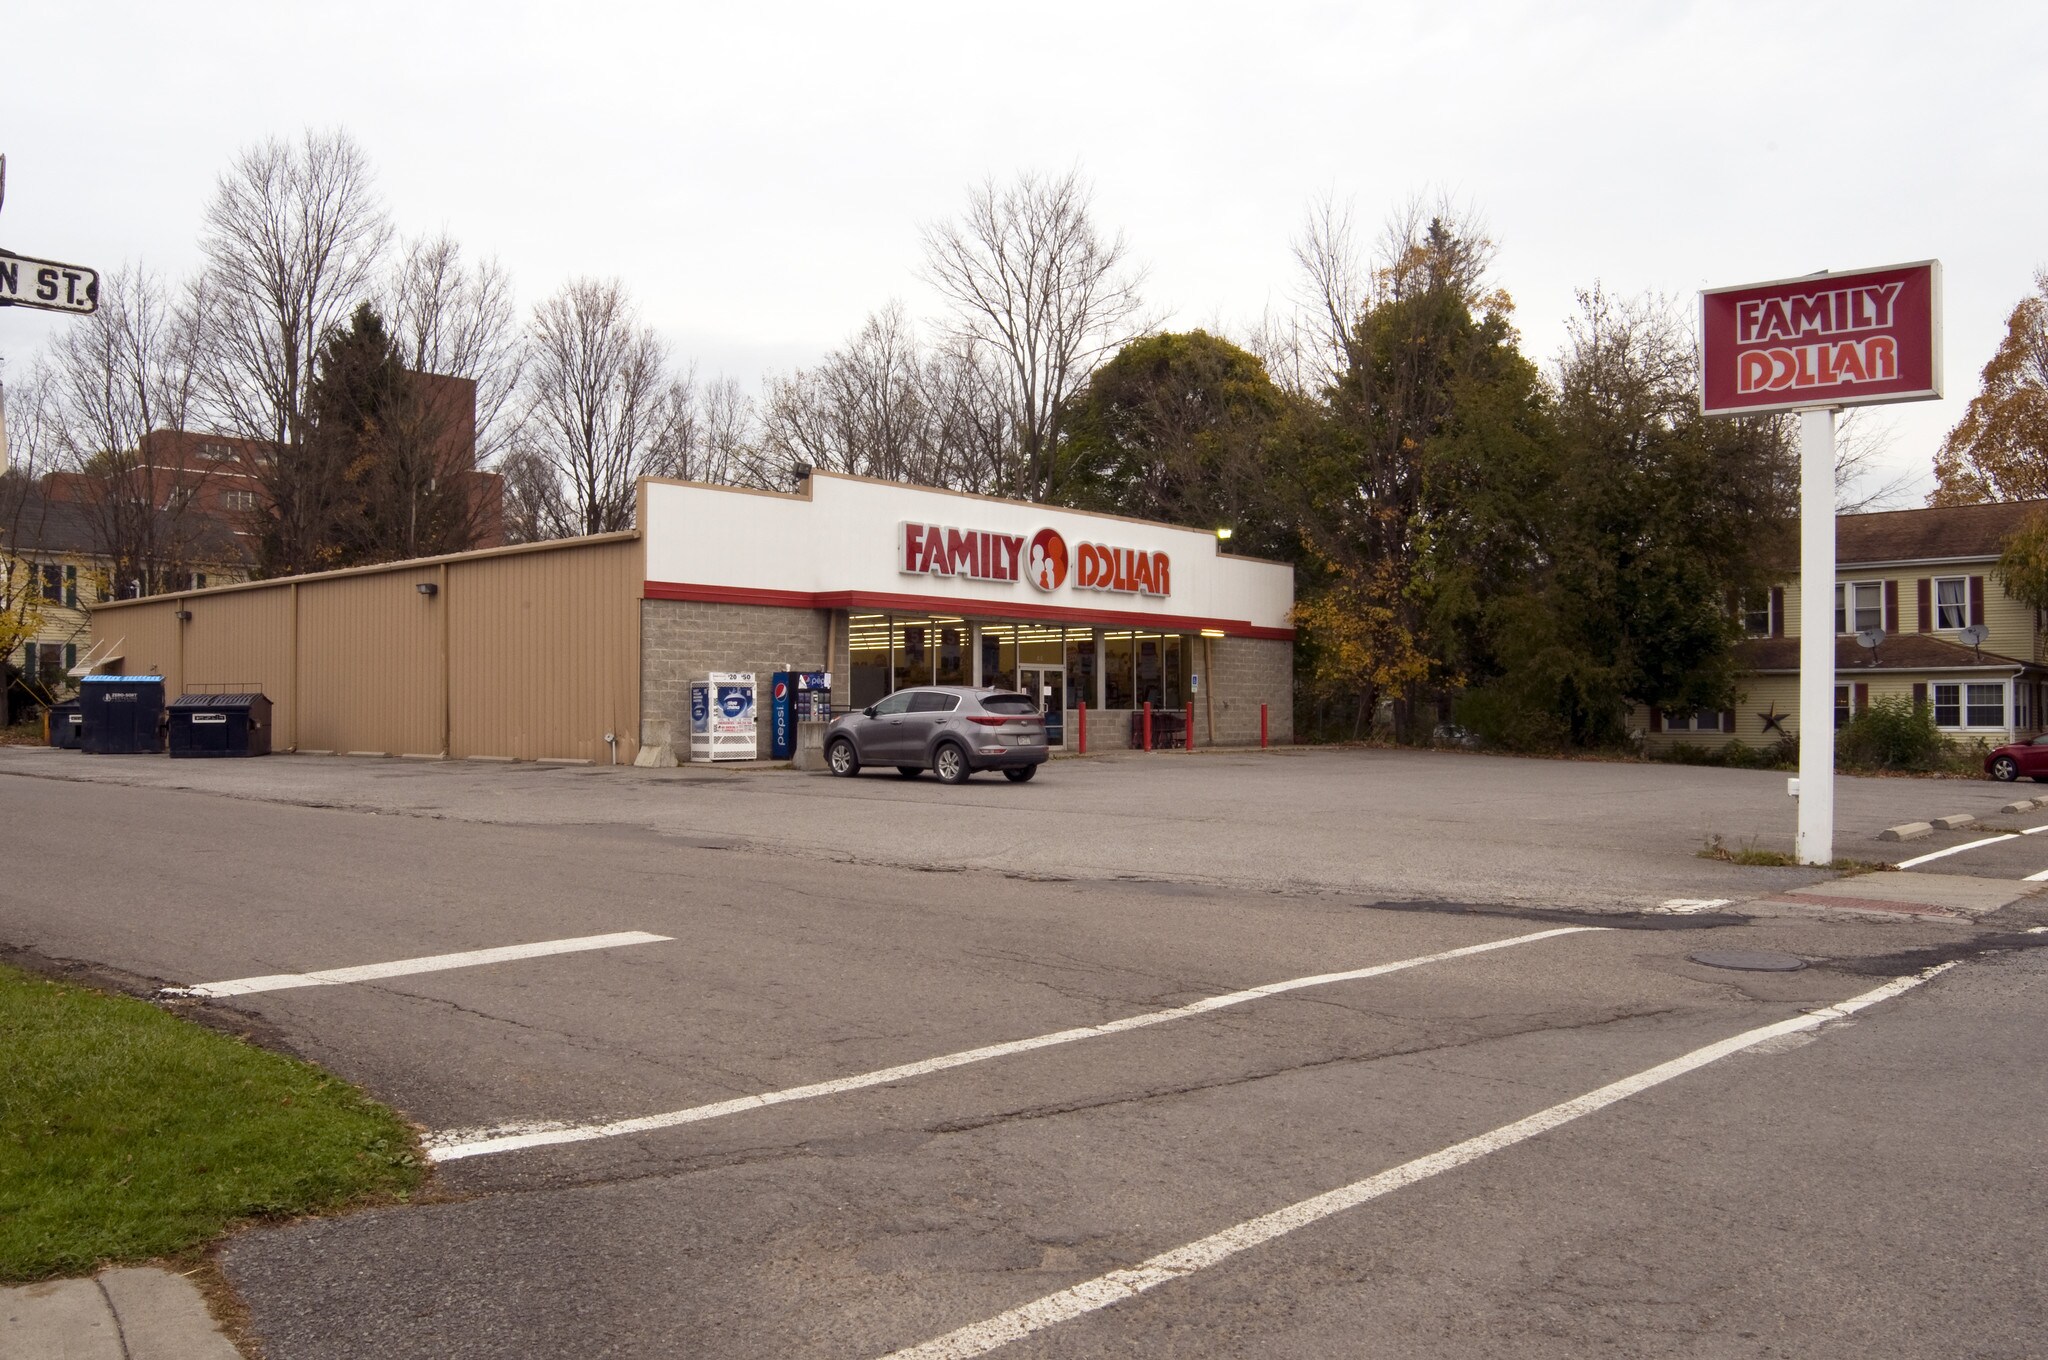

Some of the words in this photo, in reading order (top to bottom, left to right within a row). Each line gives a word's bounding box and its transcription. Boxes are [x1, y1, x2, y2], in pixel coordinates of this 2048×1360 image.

[37, 268, 85, 305] ST.
[1736, 282, 1905, 344] FAMILY
[1737, 335, 1898, 394] DOLLAR
[903, 522, 1026, 583] FAMILY
[1075, 541, 1171, 597] DOLLAR
[811, 677, 825, 686] pep
[776, 706, 786, 746] pepsi
